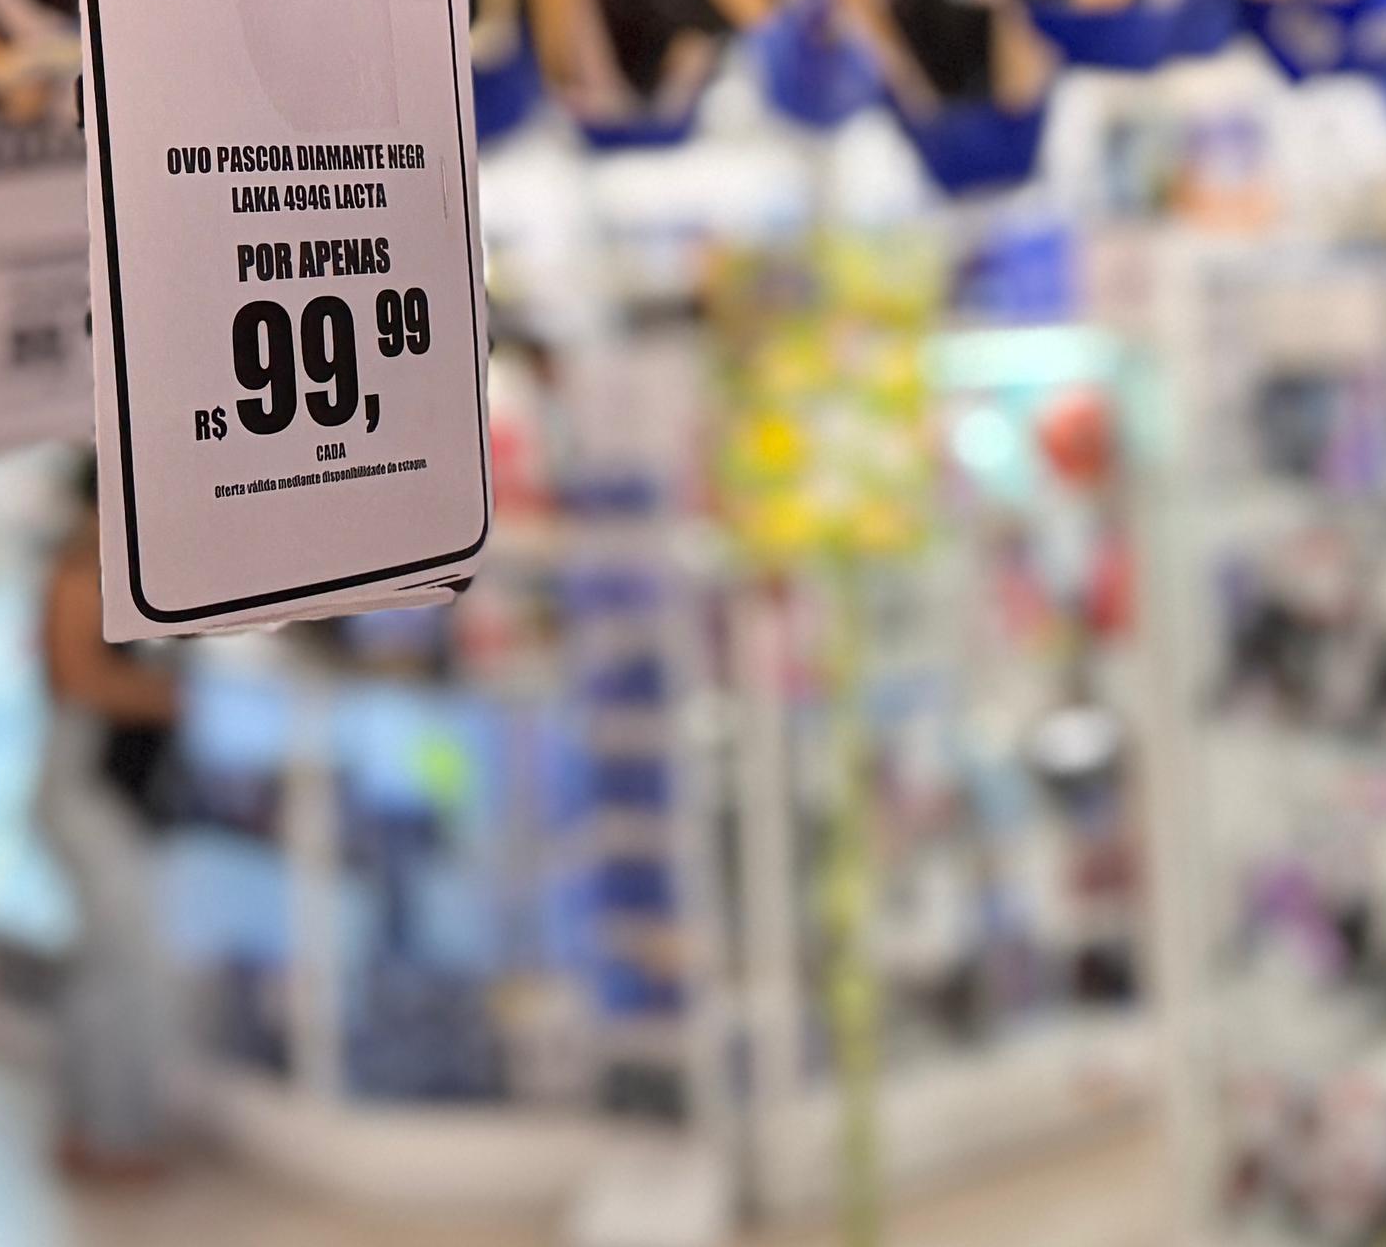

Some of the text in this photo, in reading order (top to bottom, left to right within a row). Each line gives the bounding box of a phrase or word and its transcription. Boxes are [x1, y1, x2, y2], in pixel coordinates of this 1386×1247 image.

[167, 144, 425, 175] OVO PASCOA DIAMANTE NEGR
[231, 183, 387, 213] LAKA 494G LACTA
[237, 237, 391, 283] POR APENAS
[194, 405, 227, 442] R$
[315, 442, 347, 462] CADA
[214, 483, 245, 499] Oferta
[247, 479, 277, 495] válida
[278, 472, 321, 490] mediante
[322, 461, 386, 483] disponibilidade
